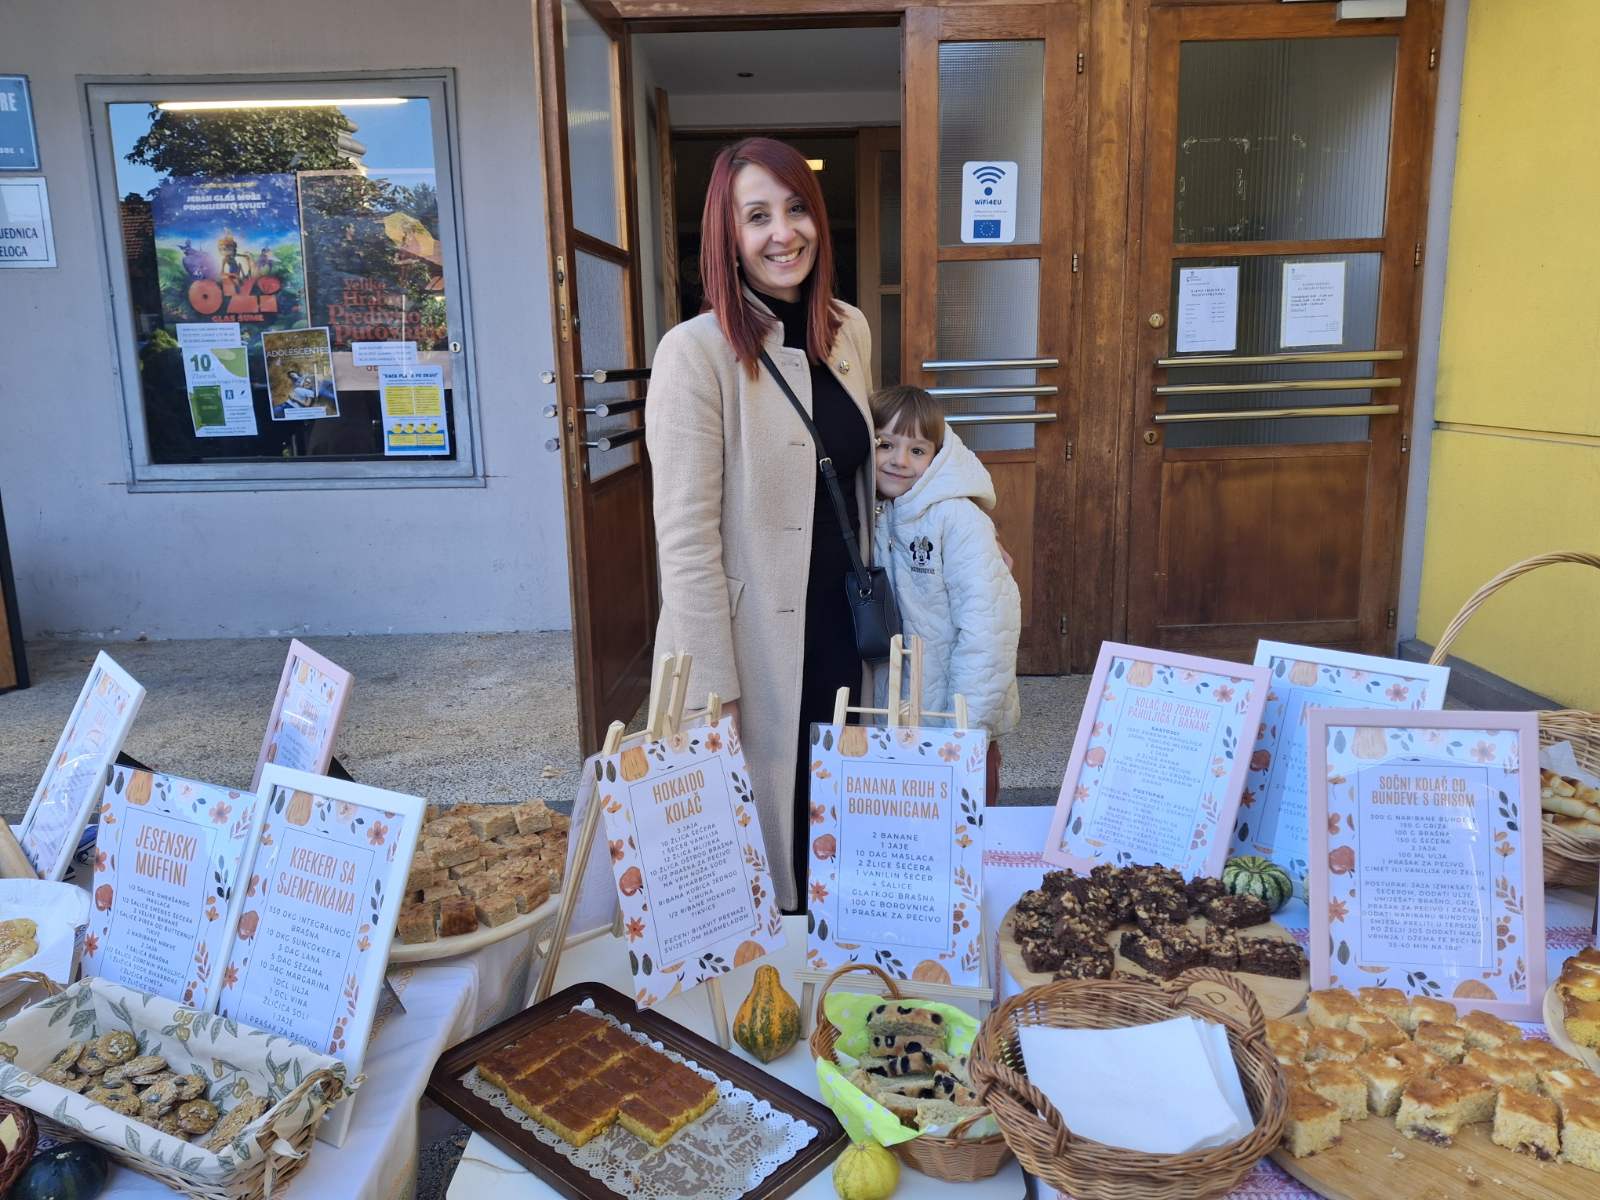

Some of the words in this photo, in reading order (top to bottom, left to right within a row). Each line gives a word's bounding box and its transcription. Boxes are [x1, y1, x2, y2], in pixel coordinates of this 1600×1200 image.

[190, 354, 212, 372] 10
[653, 770, 704, 803] HOKAIDO
[847, 776, 896, 795] BANANA
[902, 779, 934, 798] KRUH
[940, 782, 947, 799] S
[1379, 774, 1410, 790] SOČNI
[1415, 776, 1447, 791] KOLAČ
[1452, 778, 1466, 792] OD
[1372, 791, 1418, 805] BUNDEVE
[665, 792, 702, 824] KOLAČ
[849, 797, 939, 819] BOROVNICAMA
[136, 826, 197, 861] JESENSKI
[881, 832, 918, 841] BANANE
[888, 842, 908, 850] JAJE
[866, 859, 891, 868] ŽLICE
[869, 850, 887, 858] DAG
[891, 853, 934, 861] MASLACA
[136, 852, 187, 886] MUFFINI
[290, 847, 337, 879] KREKERI
[339, 860, 355, 885] SA
[863, 870, 899, 879] VANILIN
[277, 872, 354, 914] SJEMENKAMA
[898, 892, 934, 902] BRAŠNA
[852, 898, 866, 906] 100
[880, 901, 934, 912] BOROVNICA
[852, 908, 887, 918] PRAŠAK
[906, 913, 940, 923] PECIVO
